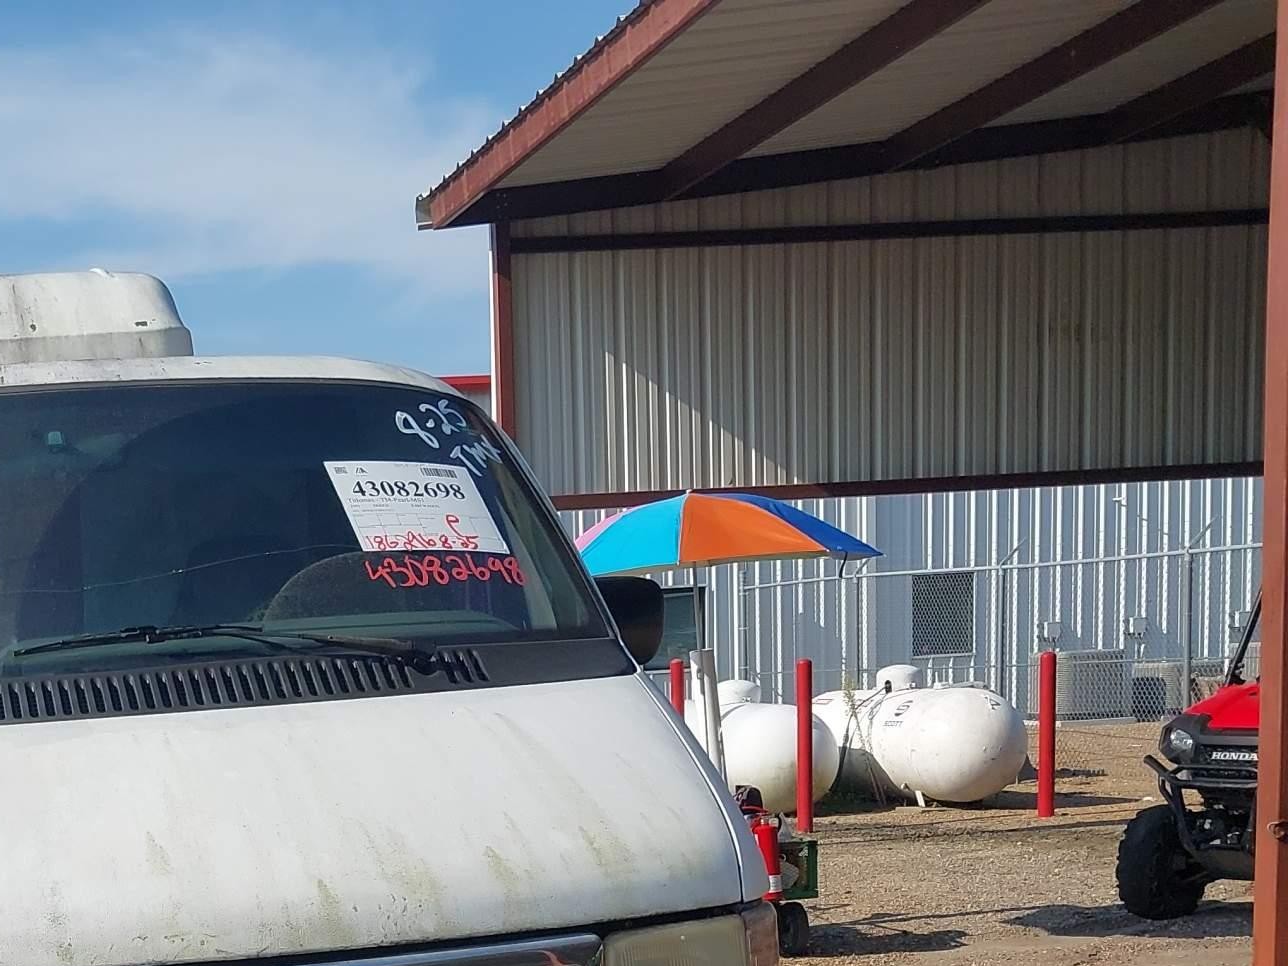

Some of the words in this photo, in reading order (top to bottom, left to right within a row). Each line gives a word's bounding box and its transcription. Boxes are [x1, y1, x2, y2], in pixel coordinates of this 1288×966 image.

[352, 480, 466, 500] 43082698
[364, 553, 527, 588] 43082698
[1211, 751, 1259, 761] HONDA
